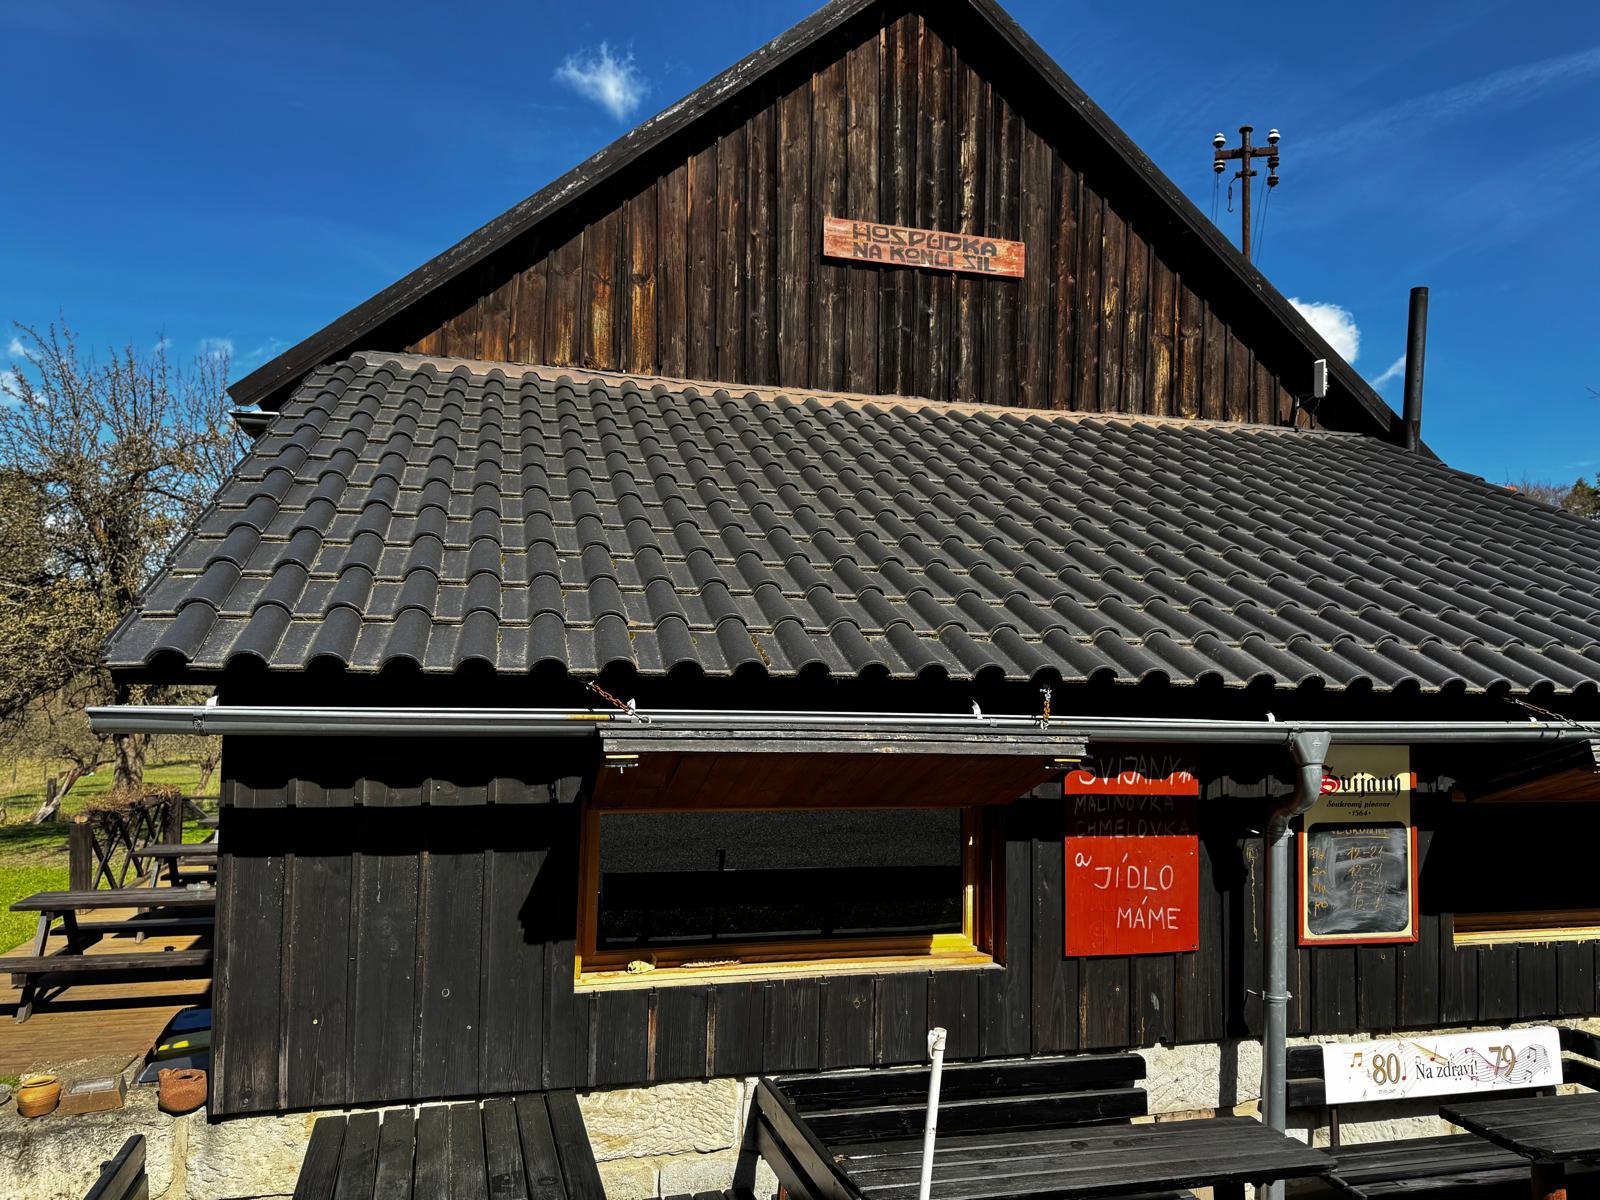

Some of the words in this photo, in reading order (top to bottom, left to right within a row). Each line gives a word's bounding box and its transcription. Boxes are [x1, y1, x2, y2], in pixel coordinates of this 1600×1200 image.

[853, 223, 998, 257] HOSPUDKA
[853, 242, 882, 259] NA
[889, 246, 955, 267] KONCI
[962, 255, 998, 272] SIL
[1078, 753, 1181, 786] SVIJANY
[1319, 765, 1401, 798] Svijany
[1073, 795, 1176, 815] MALINOVKA
[1074, 816, 1192, 839] CHMELOVKA
[1093, 852, 1175, 890] JÍDLO
[1116, 895, 1181, 930] MÁME
[1371, 1053, 1400, 1085] 80
[1415, 1063, 1433, 1080] Na
[1436, 1058, 1478, 1079] zdraví!
[1488, 1044, 1516, 1078] 79
